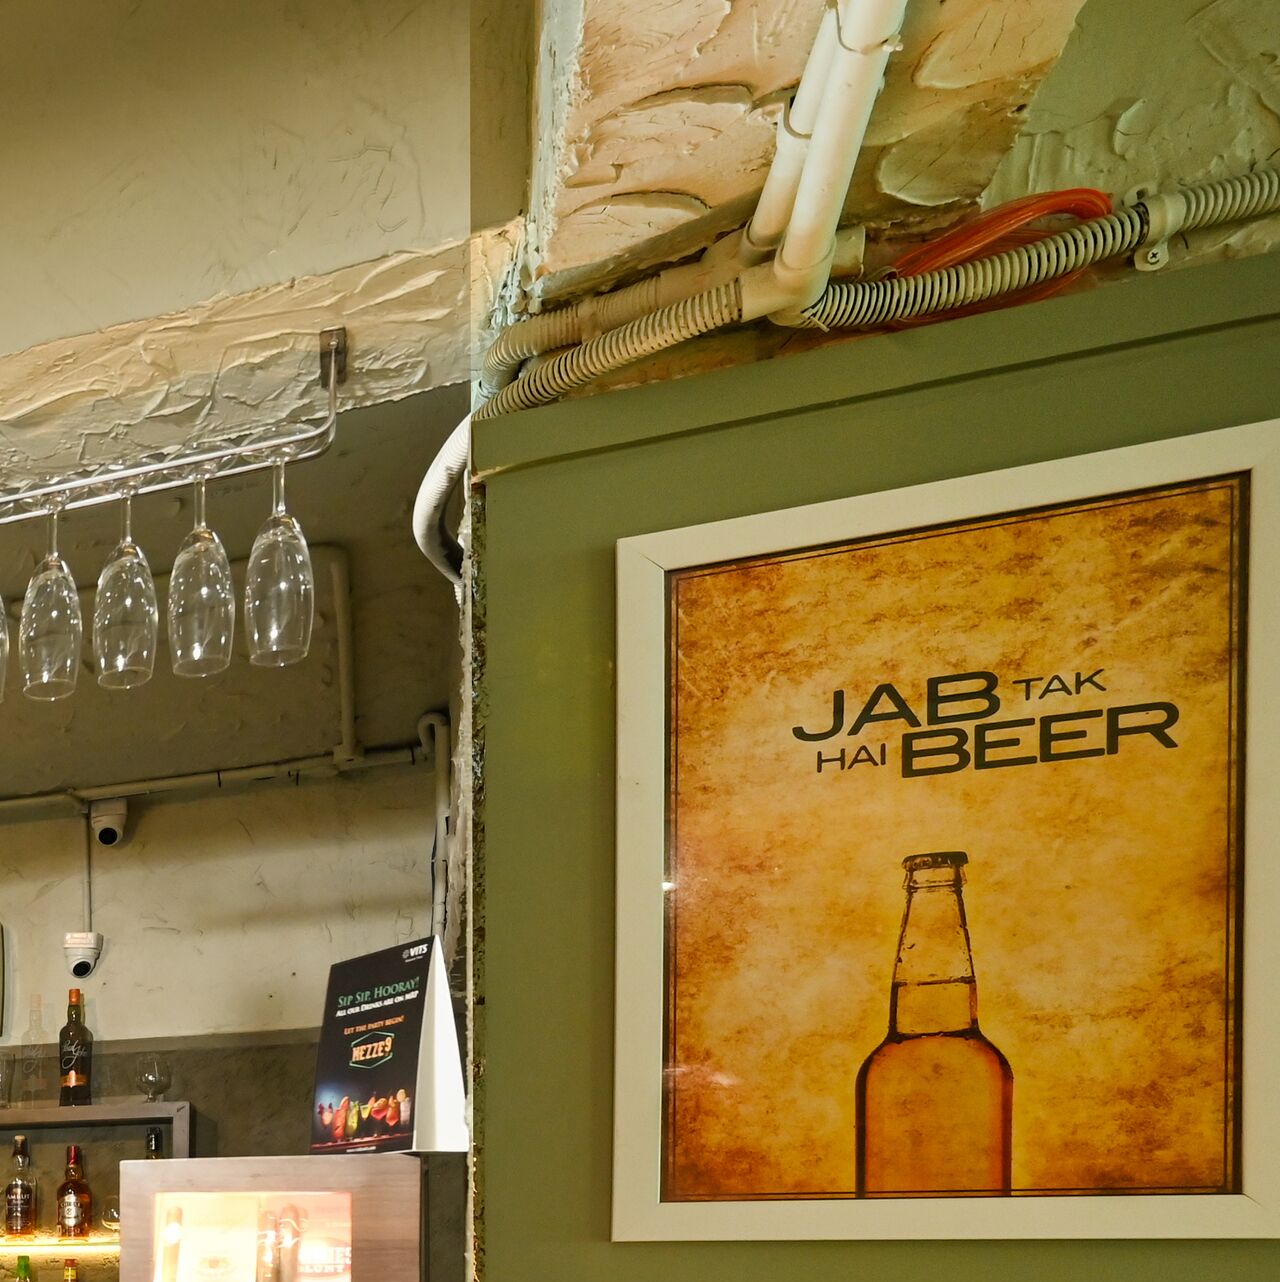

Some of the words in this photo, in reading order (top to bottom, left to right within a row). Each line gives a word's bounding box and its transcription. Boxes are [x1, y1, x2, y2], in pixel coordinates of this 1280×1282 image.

[792, 671, 1001, 742] JAB
[1012, 668, 1107, 701] TAK
[816, 742, 887, 774] HAI
[901, 701, 1180, 779] BEER
[409, 944, 429, 957] VITS
